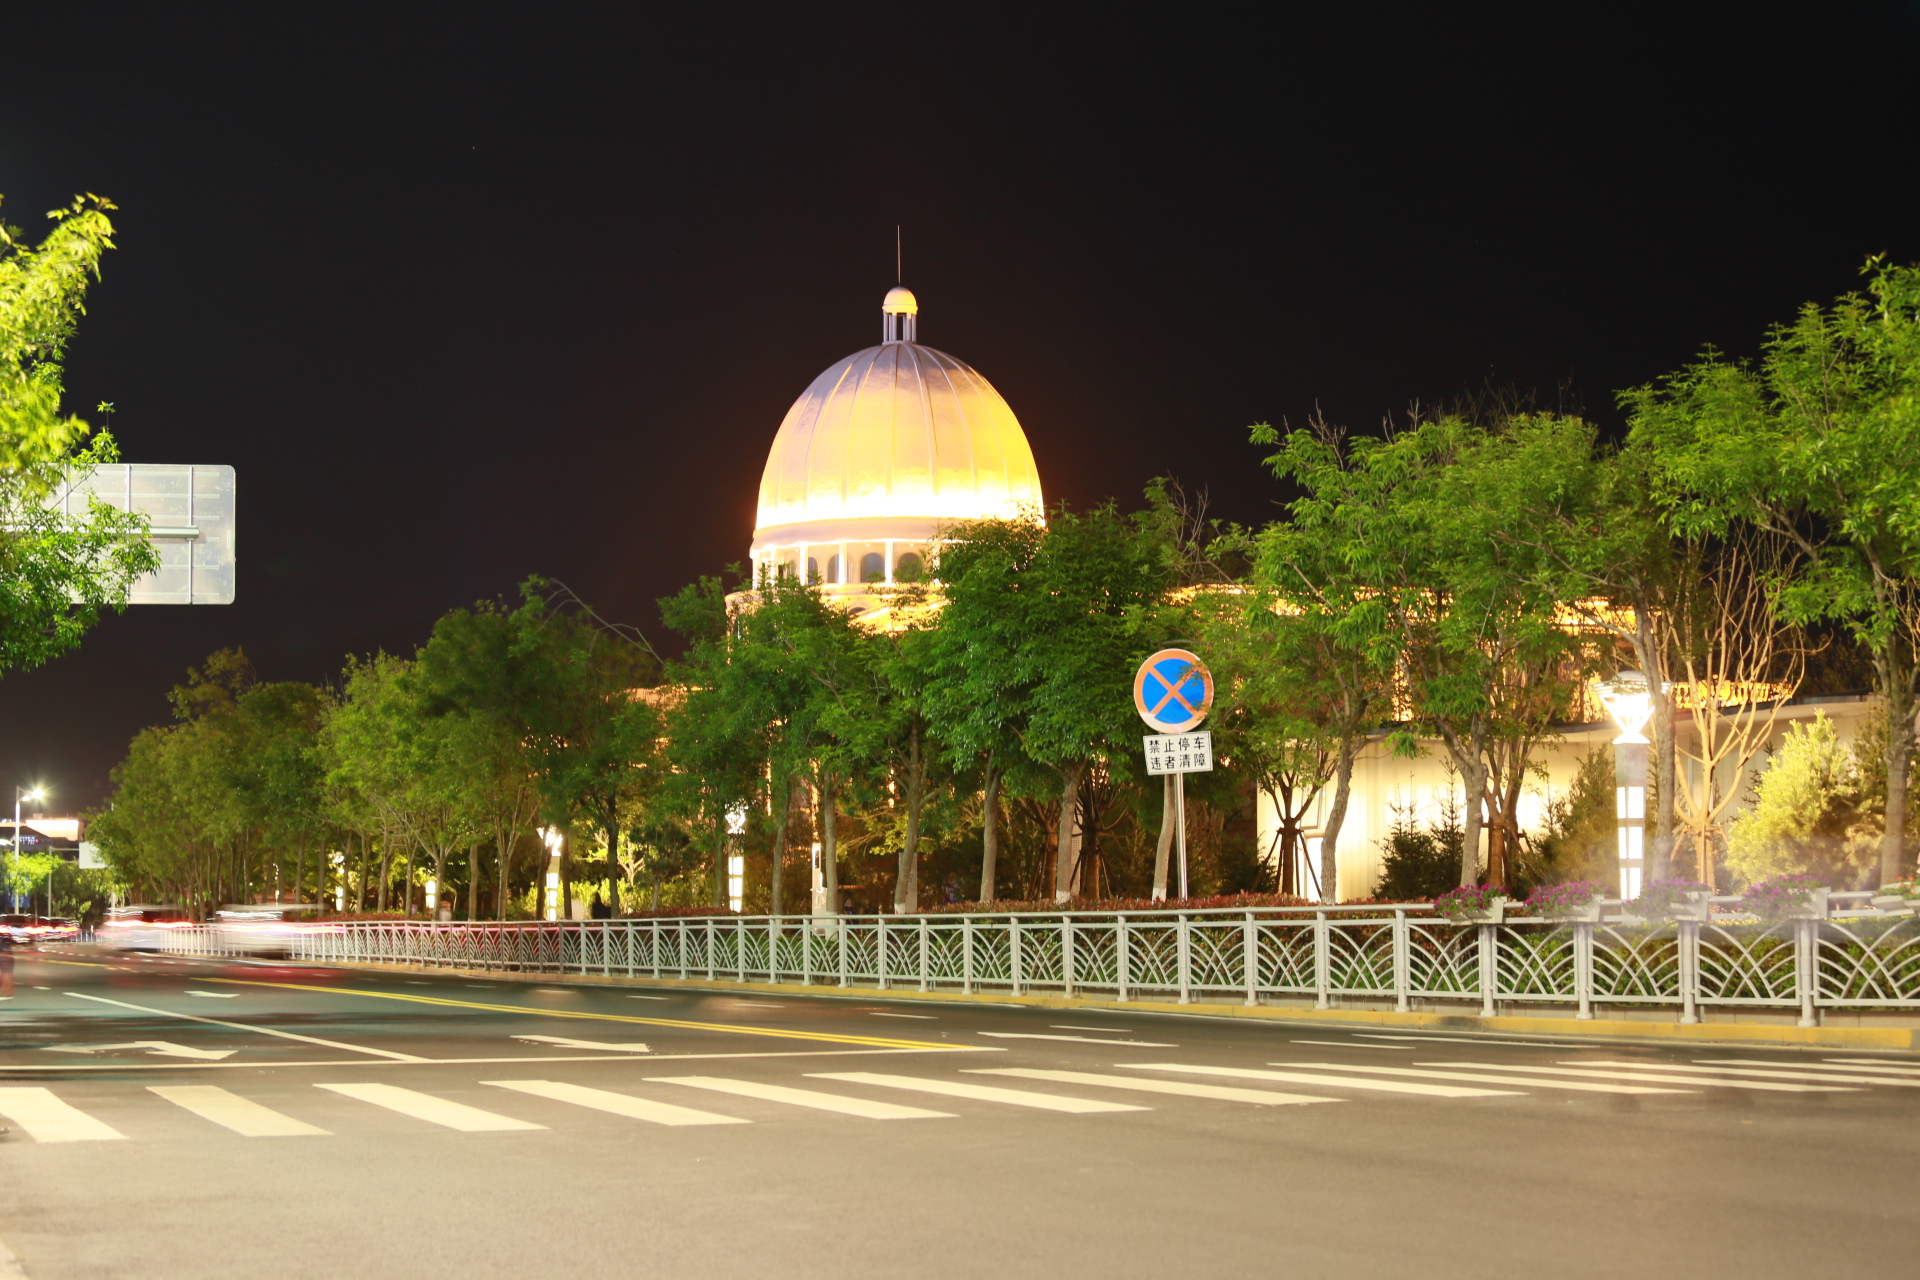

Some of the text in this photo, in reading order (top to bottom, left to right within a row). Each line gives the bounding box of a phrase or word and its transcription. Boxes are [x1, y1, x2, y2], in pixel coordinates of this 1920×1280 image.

[1149, 736, 1205, 754] 禁止停车
[1150, 752, 1206, 770] 违者清障
